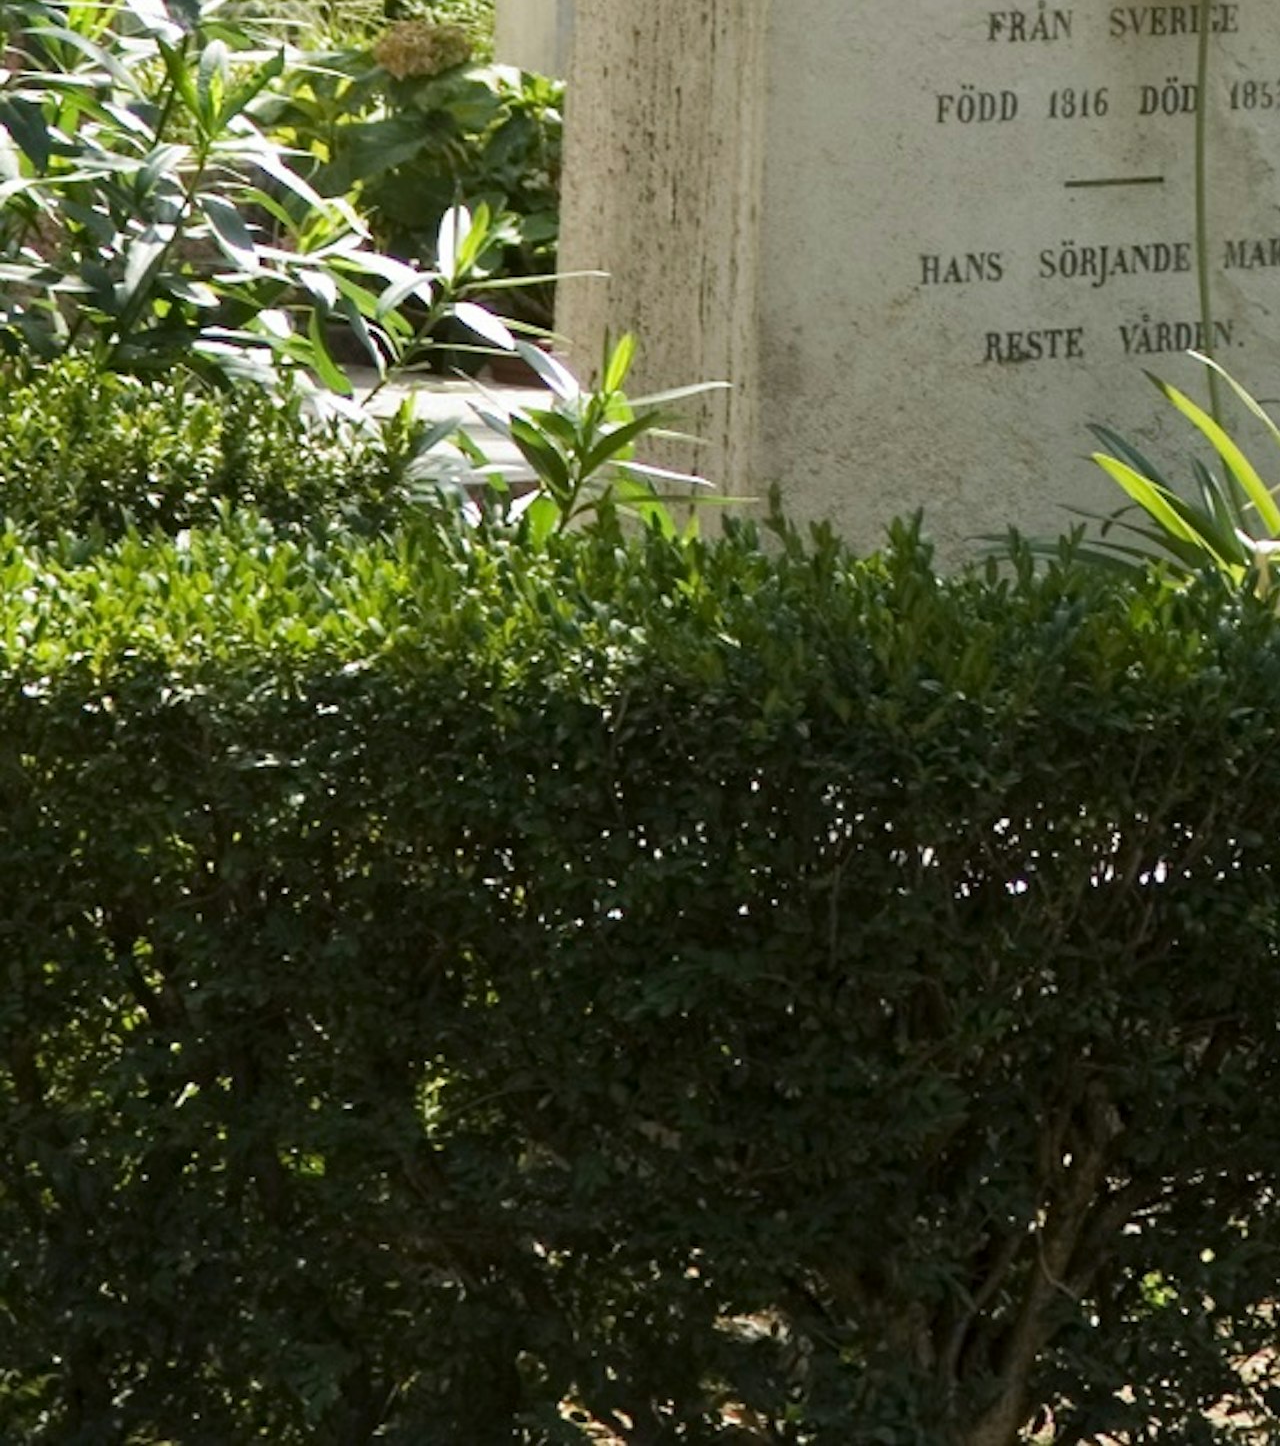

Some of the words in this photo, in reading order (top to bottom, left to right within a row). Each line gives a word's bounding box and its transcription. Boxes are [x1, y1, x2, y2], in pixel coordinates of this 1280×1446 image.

[986, 0, 1074, 43] FRÅN
[1108, 3, 1240, 38] SVERIGE
[936, 85, 1019, 124] FÖDD
[1047, 86, 1110, 120] 1816
[1138, 75, 1198, 116] DÖD
[919, 251, 1004, 286] HANS
[1038, 240, 1193, 289] SÖRJANDE
[983, 326, 1085, 364] RESTE
